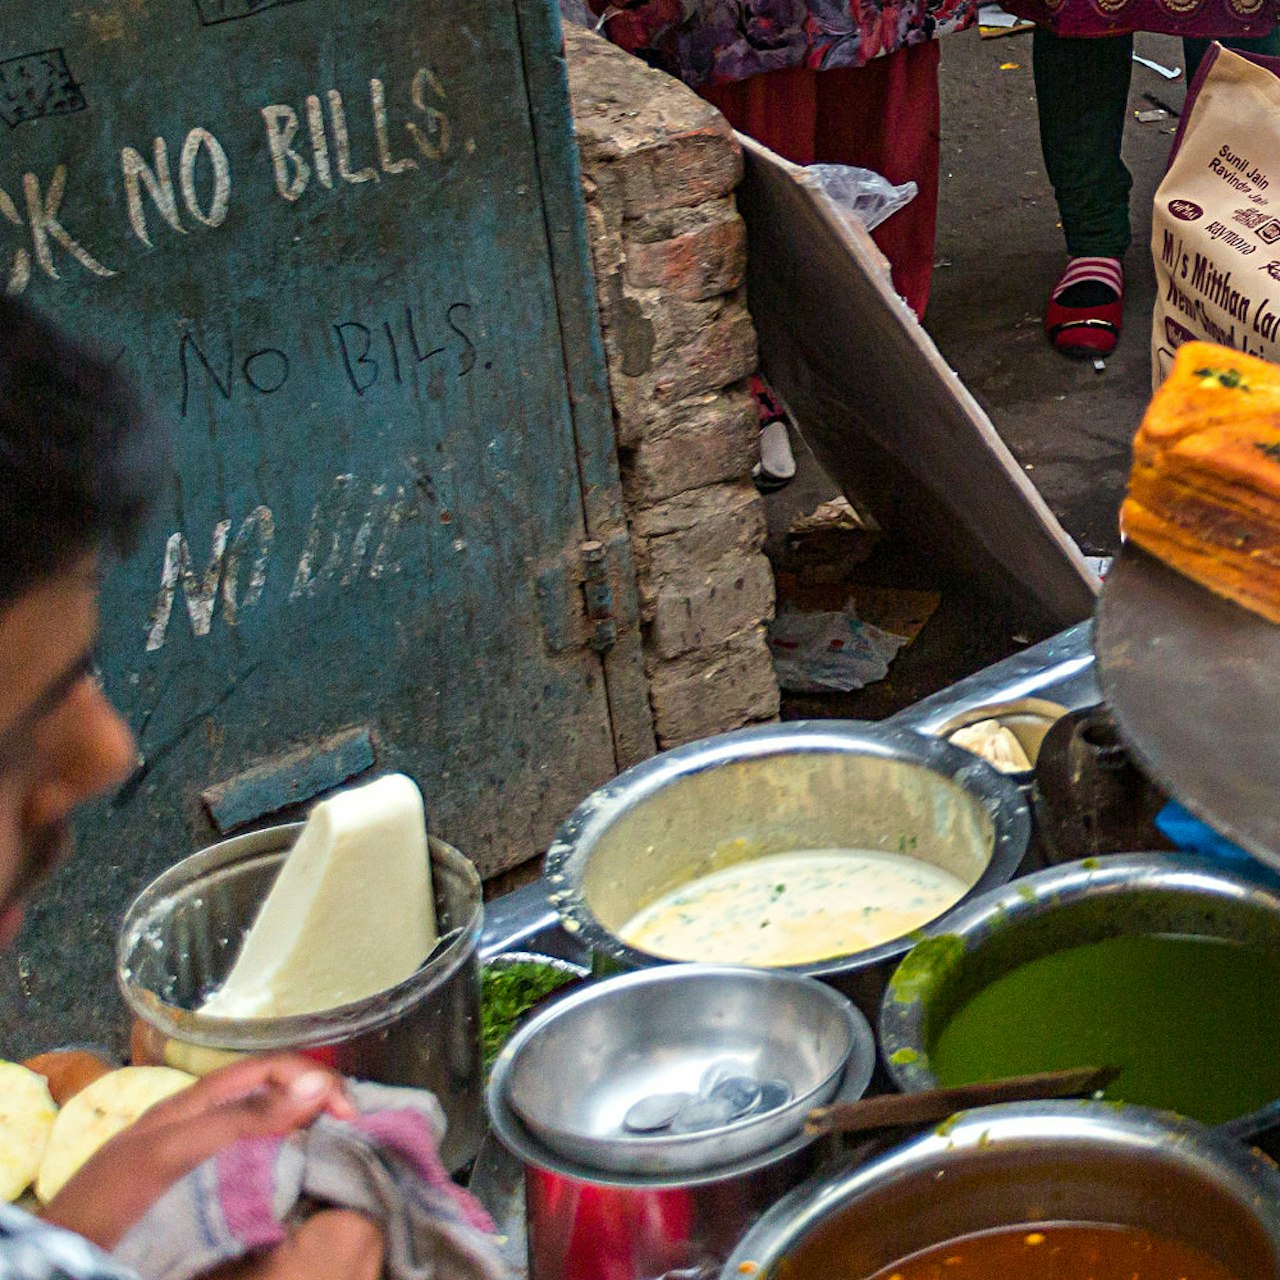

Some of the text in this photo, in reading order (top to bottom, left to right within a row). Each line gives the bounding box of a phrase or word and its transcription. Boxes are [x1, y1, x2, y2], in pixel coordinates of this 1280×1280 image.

[121, 127, 231, 248] NO
[1219, 144, 1269, 191] Sunil Jain
[1191, 253, 1250, 324] Mitthan
